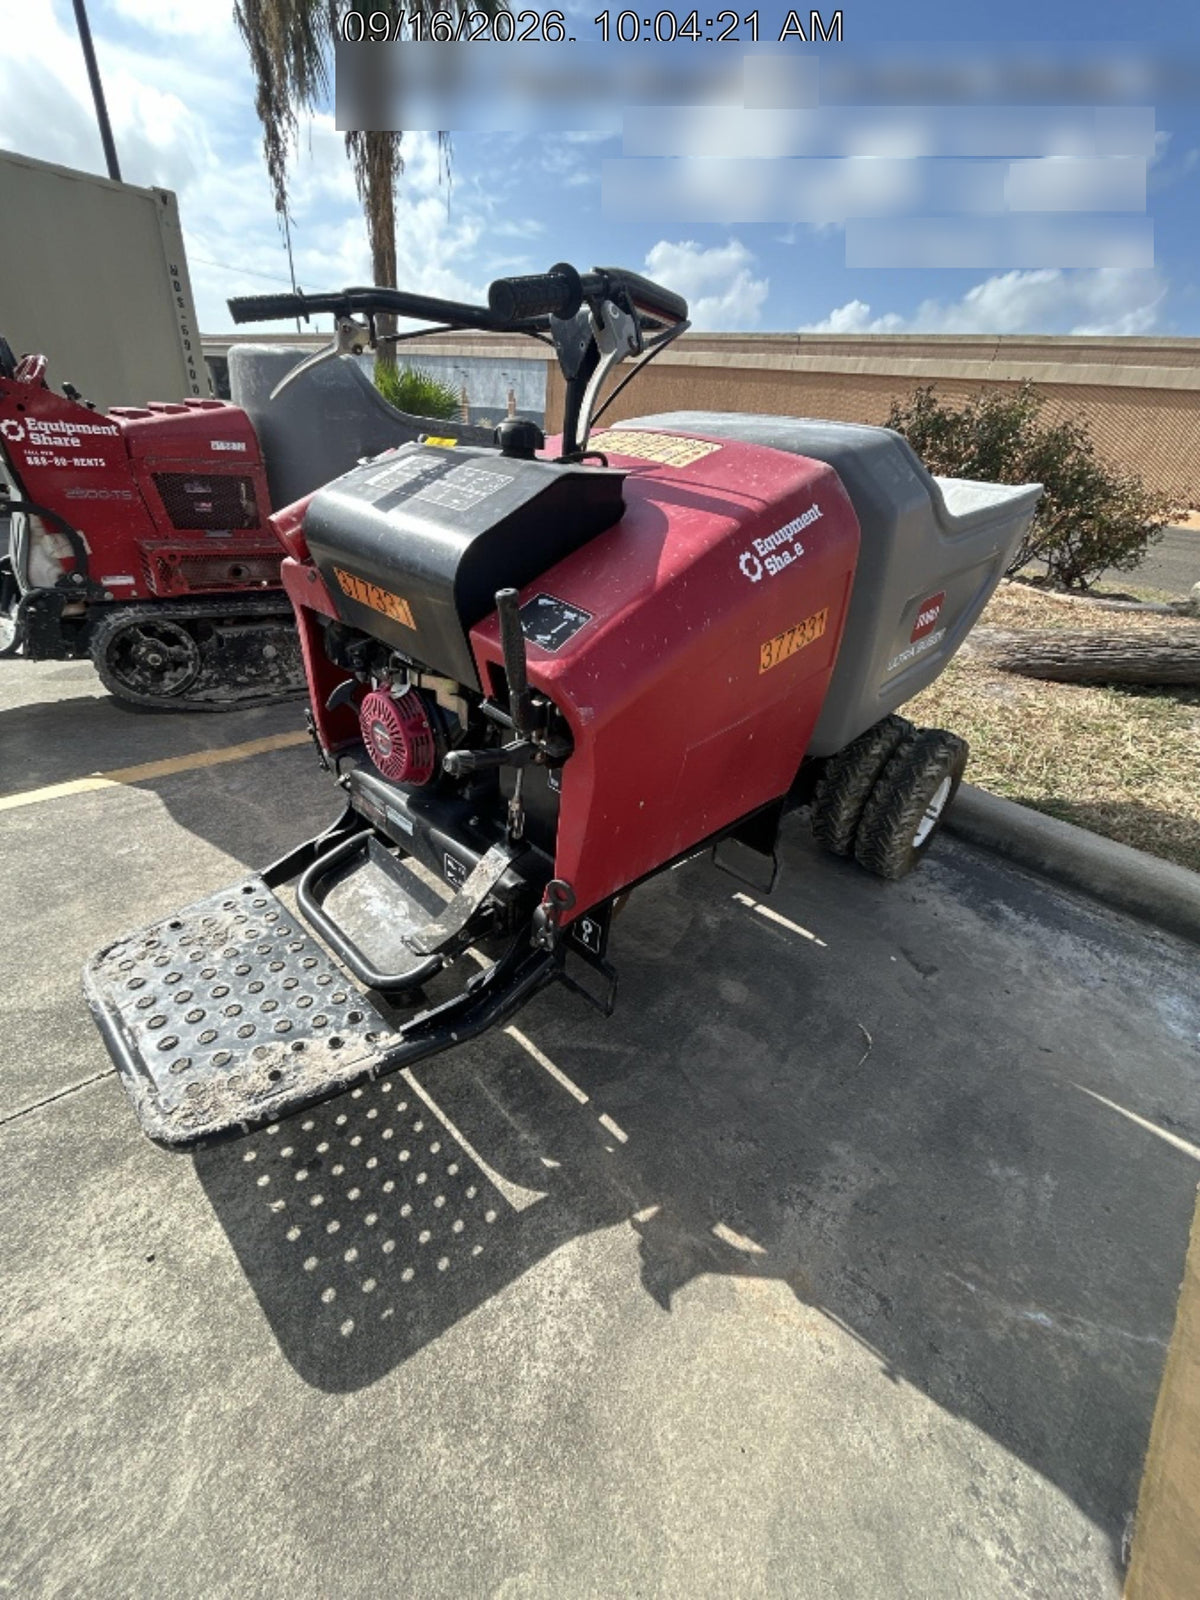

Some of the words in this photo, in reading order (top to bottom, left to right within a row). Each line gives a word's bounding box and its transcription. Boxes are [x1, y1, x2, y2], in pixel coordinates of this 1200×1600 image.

[24, 417, 119, 436] Equipment
[29, 432, 81, 447] Share
[752, 503, 824, 557] Equipment
[764, 542, 805, 576] Shae
[336, 568, 413, 628] 377331
[761, 609, 825, 670] 377331
